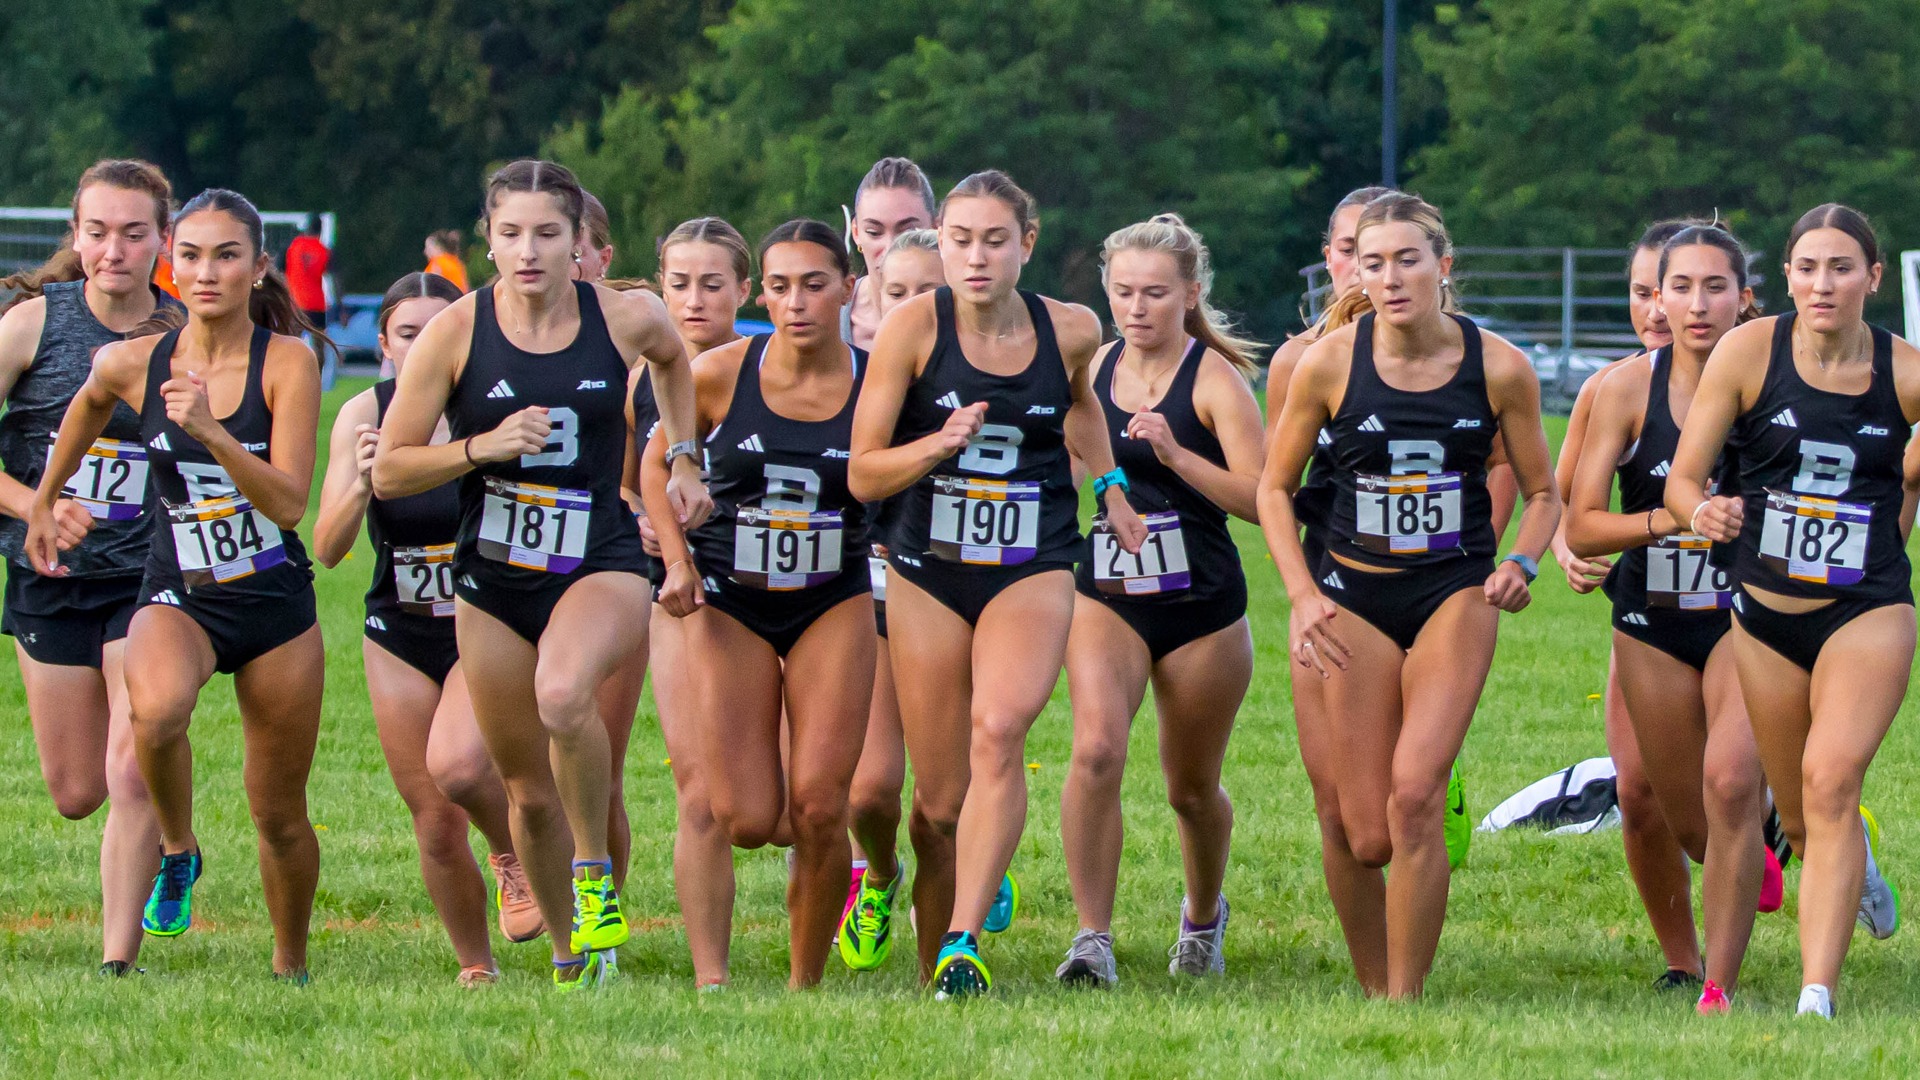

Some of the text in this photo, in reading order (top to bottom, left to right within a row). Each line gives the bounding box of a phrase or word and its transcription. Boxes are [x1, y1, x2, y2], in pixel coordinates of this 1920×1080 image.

[61, 457, 131, 502] 12
[1792, 439, 1856, 497] B
[502, 501, 568, 554] 181
[951, 499, 1020, 546] 190
[1375, 492, 1444, 535] 185
[190, 511, 264, 566] 184
[755, 529, 821, 573] 191
[1782, 516, 1849, 566] 182
